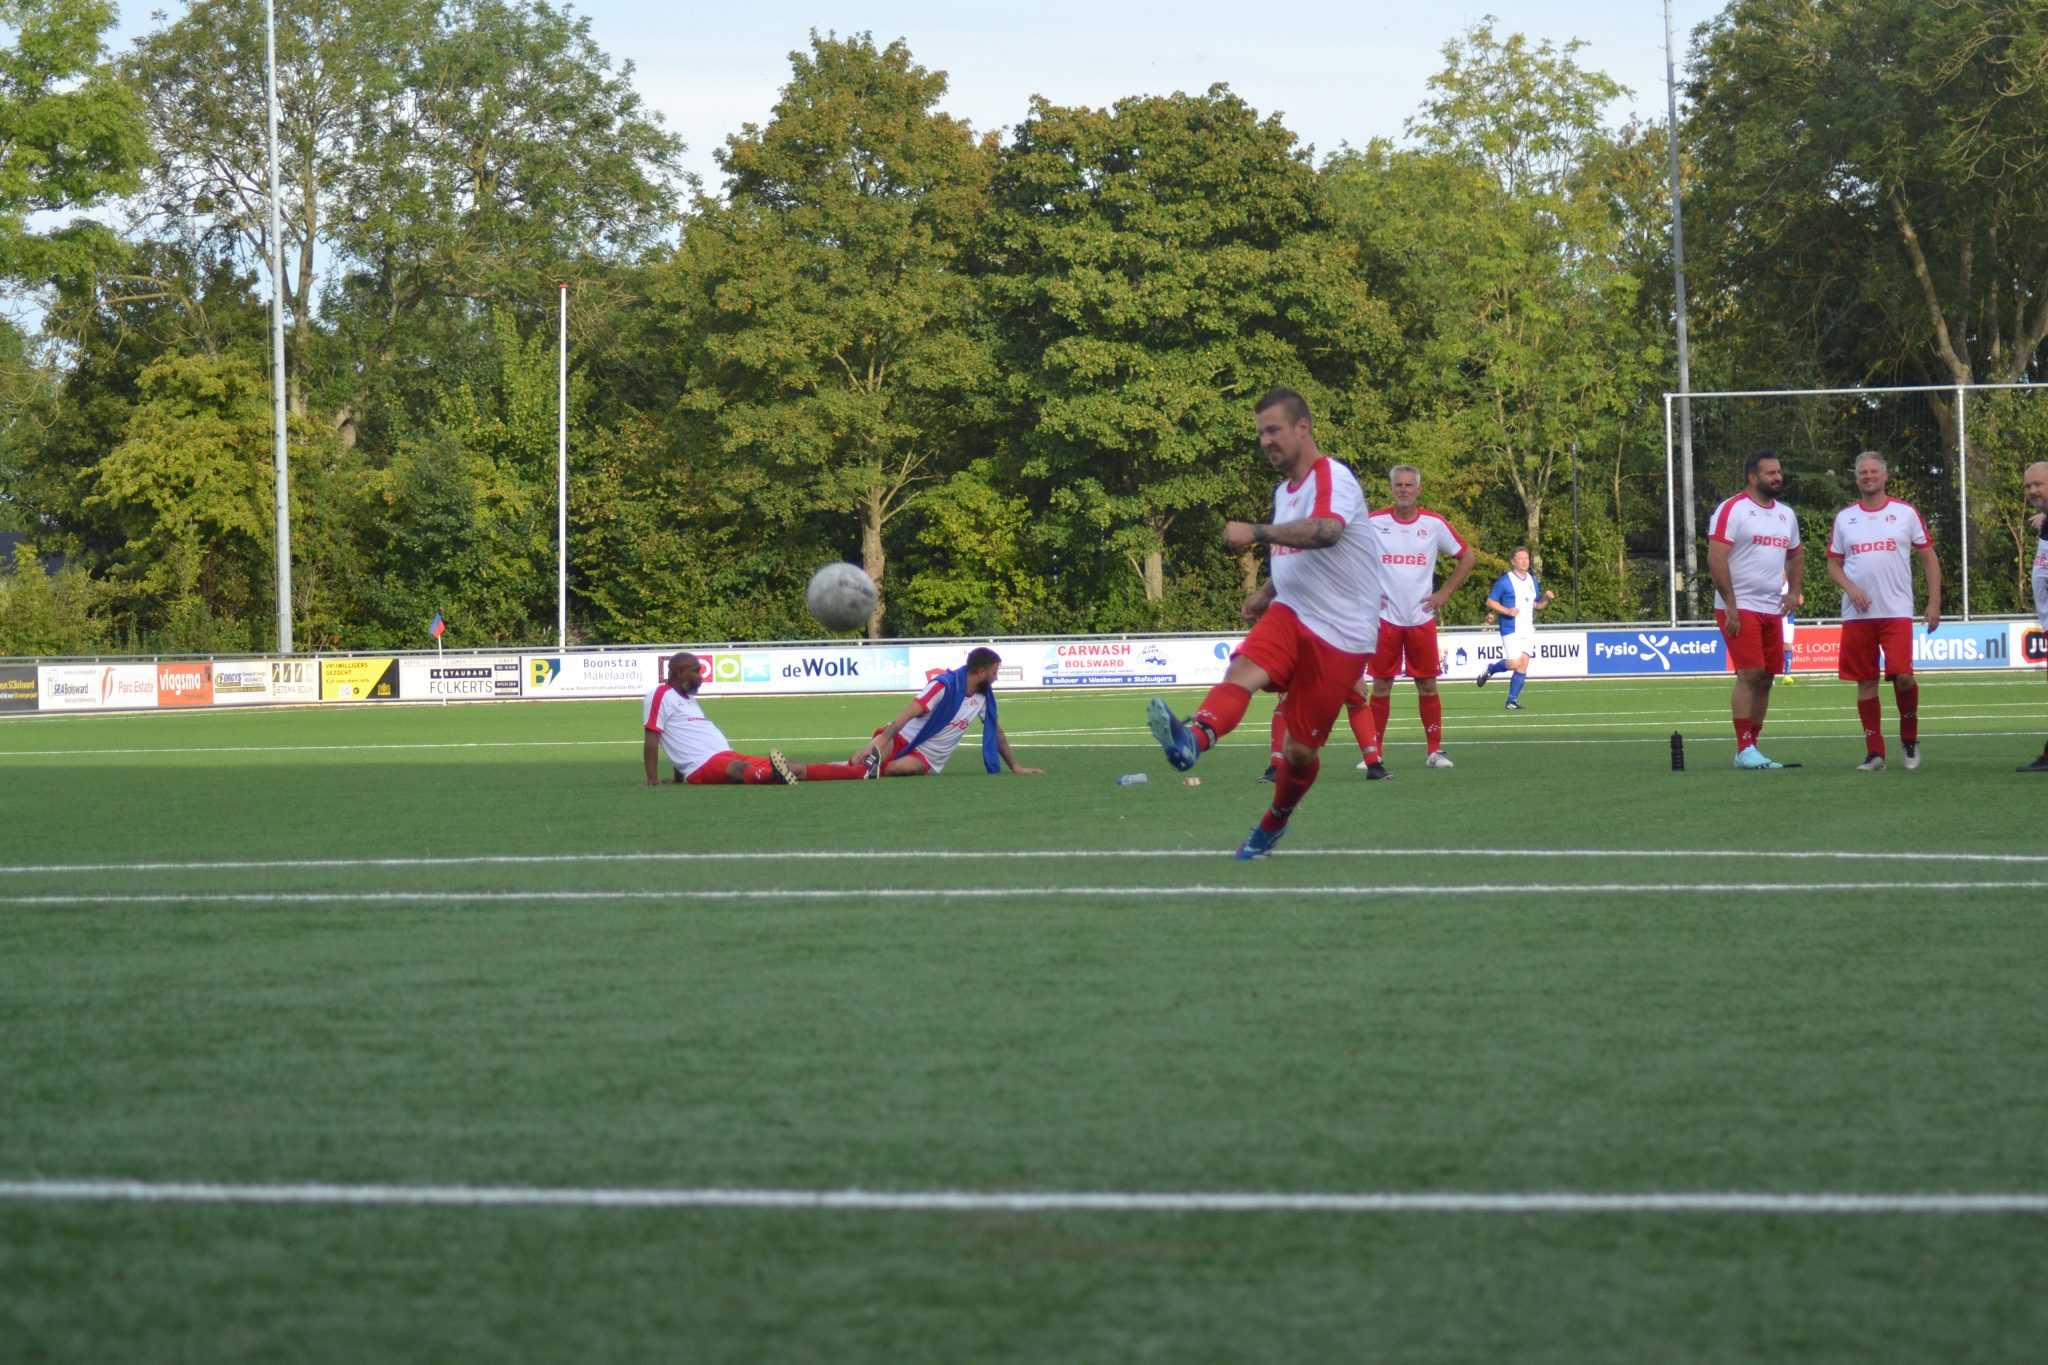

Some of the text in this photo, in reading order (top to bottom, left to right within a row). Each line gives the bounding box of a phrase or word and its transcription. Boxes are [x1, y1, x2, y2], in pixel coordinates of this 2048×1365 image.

[1057, 644, 1131, 656] CARWASH
[1541, 644, 1580, 658] BOUW
[1595, 640, 1718, 659] Fysio Actief
[1792, 643, 1803, 653] KE
[2029, 638, 2047, 653] JU
[583, 658, 637, 668] Boonstra
[1065, 660, 1124, 668] BOLSWARD
[160, 669, 201, 696] vlagsma
[584, 670, 643, 682] Makelaardij
[118, 680, 154, 694] Parc Estate
[430, 680, 493, 694] FOLKERTS
